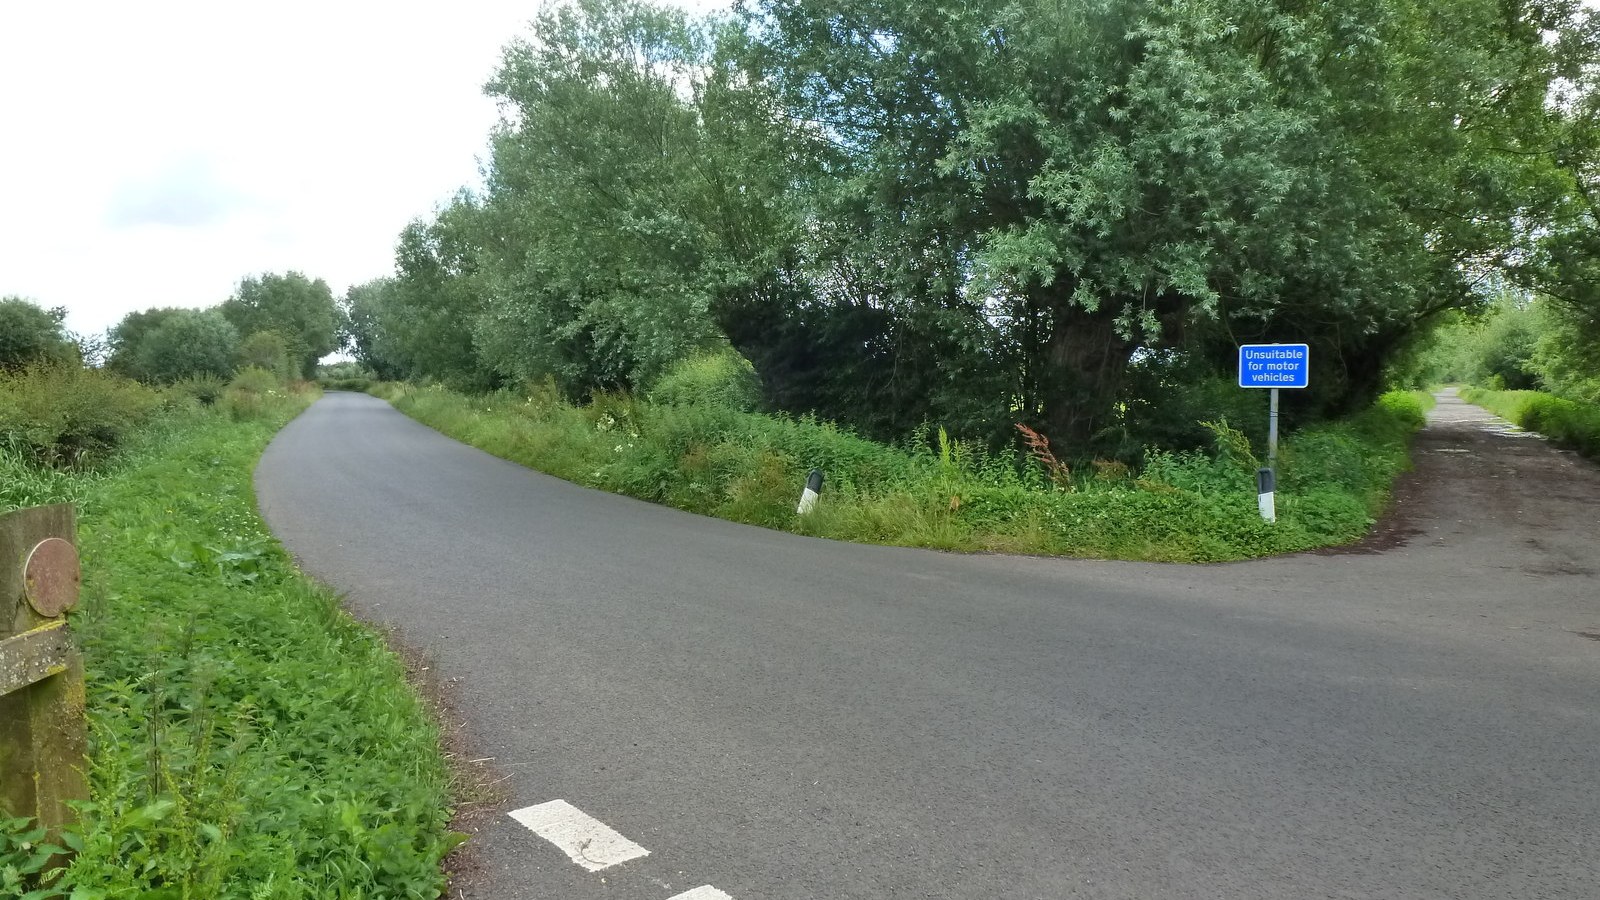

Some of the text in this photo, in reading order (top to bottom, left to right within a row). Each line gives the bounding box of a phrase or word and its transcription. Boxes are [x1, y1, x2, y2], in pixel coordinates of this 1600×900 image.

[1245, 349, 1303, 359] Unsuitable
[1248, 361, 1299, 370] for motor
[1252, 372, 1295, 382] vehicles
